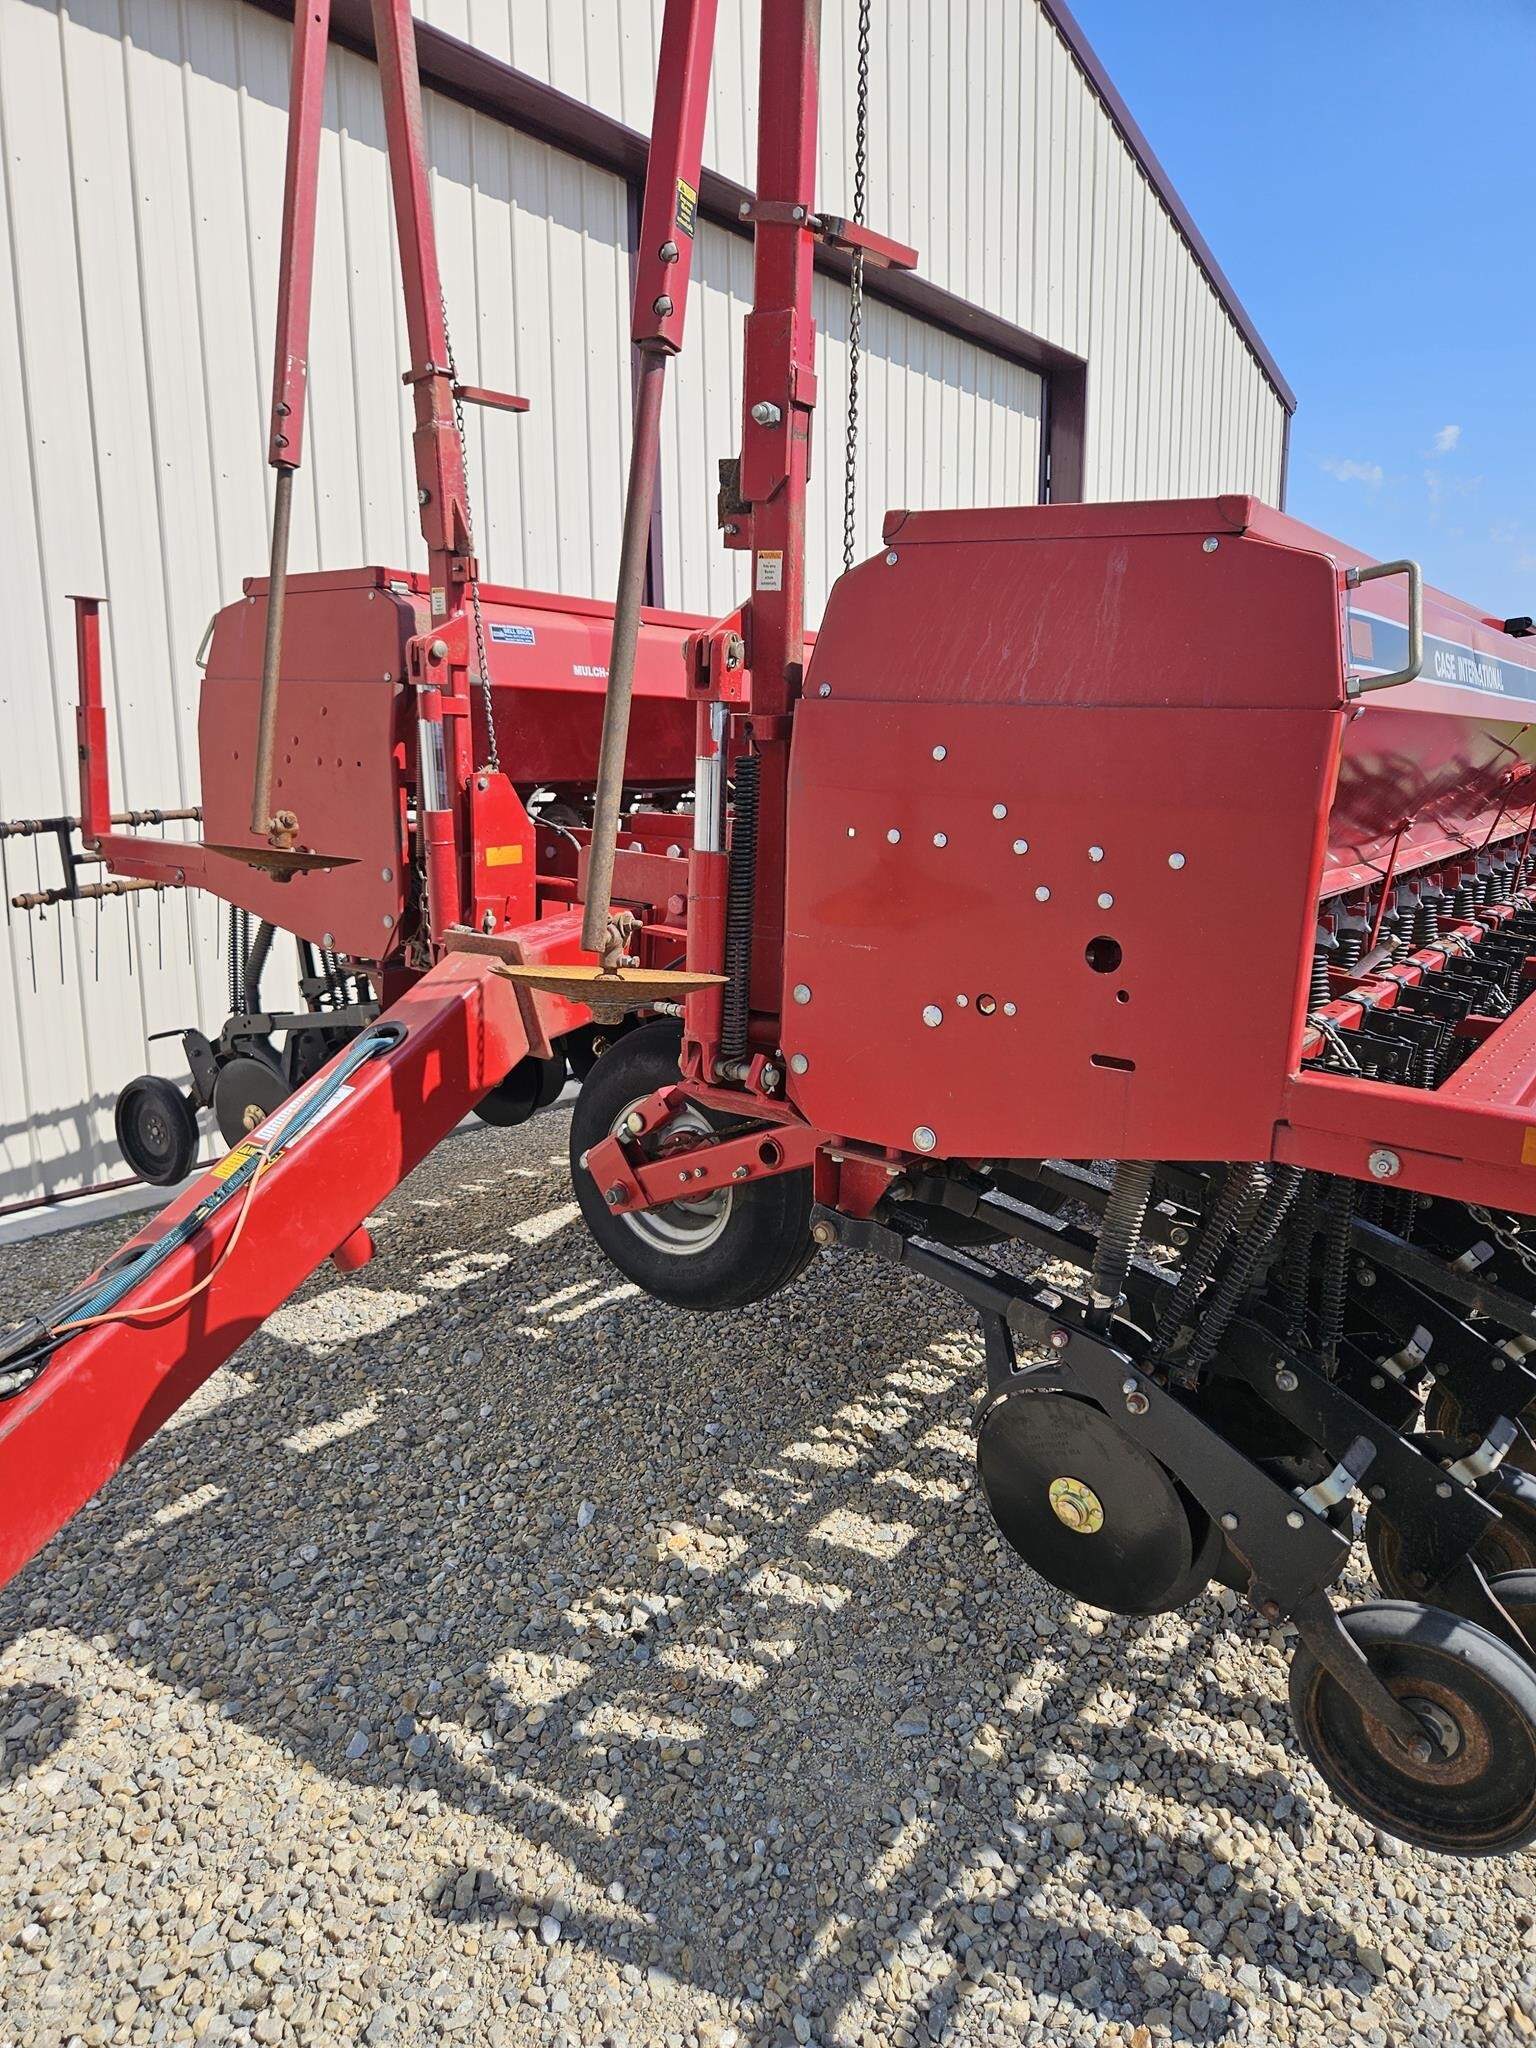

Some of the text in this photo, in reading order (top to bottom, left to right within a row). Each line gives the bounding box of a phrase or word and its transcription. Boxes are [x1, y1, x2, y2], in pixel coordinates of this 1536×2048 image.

[573, 664, 609, 678] MULCH-
[1434, 650, 1504, 691] CASE INTERNATIONAL
